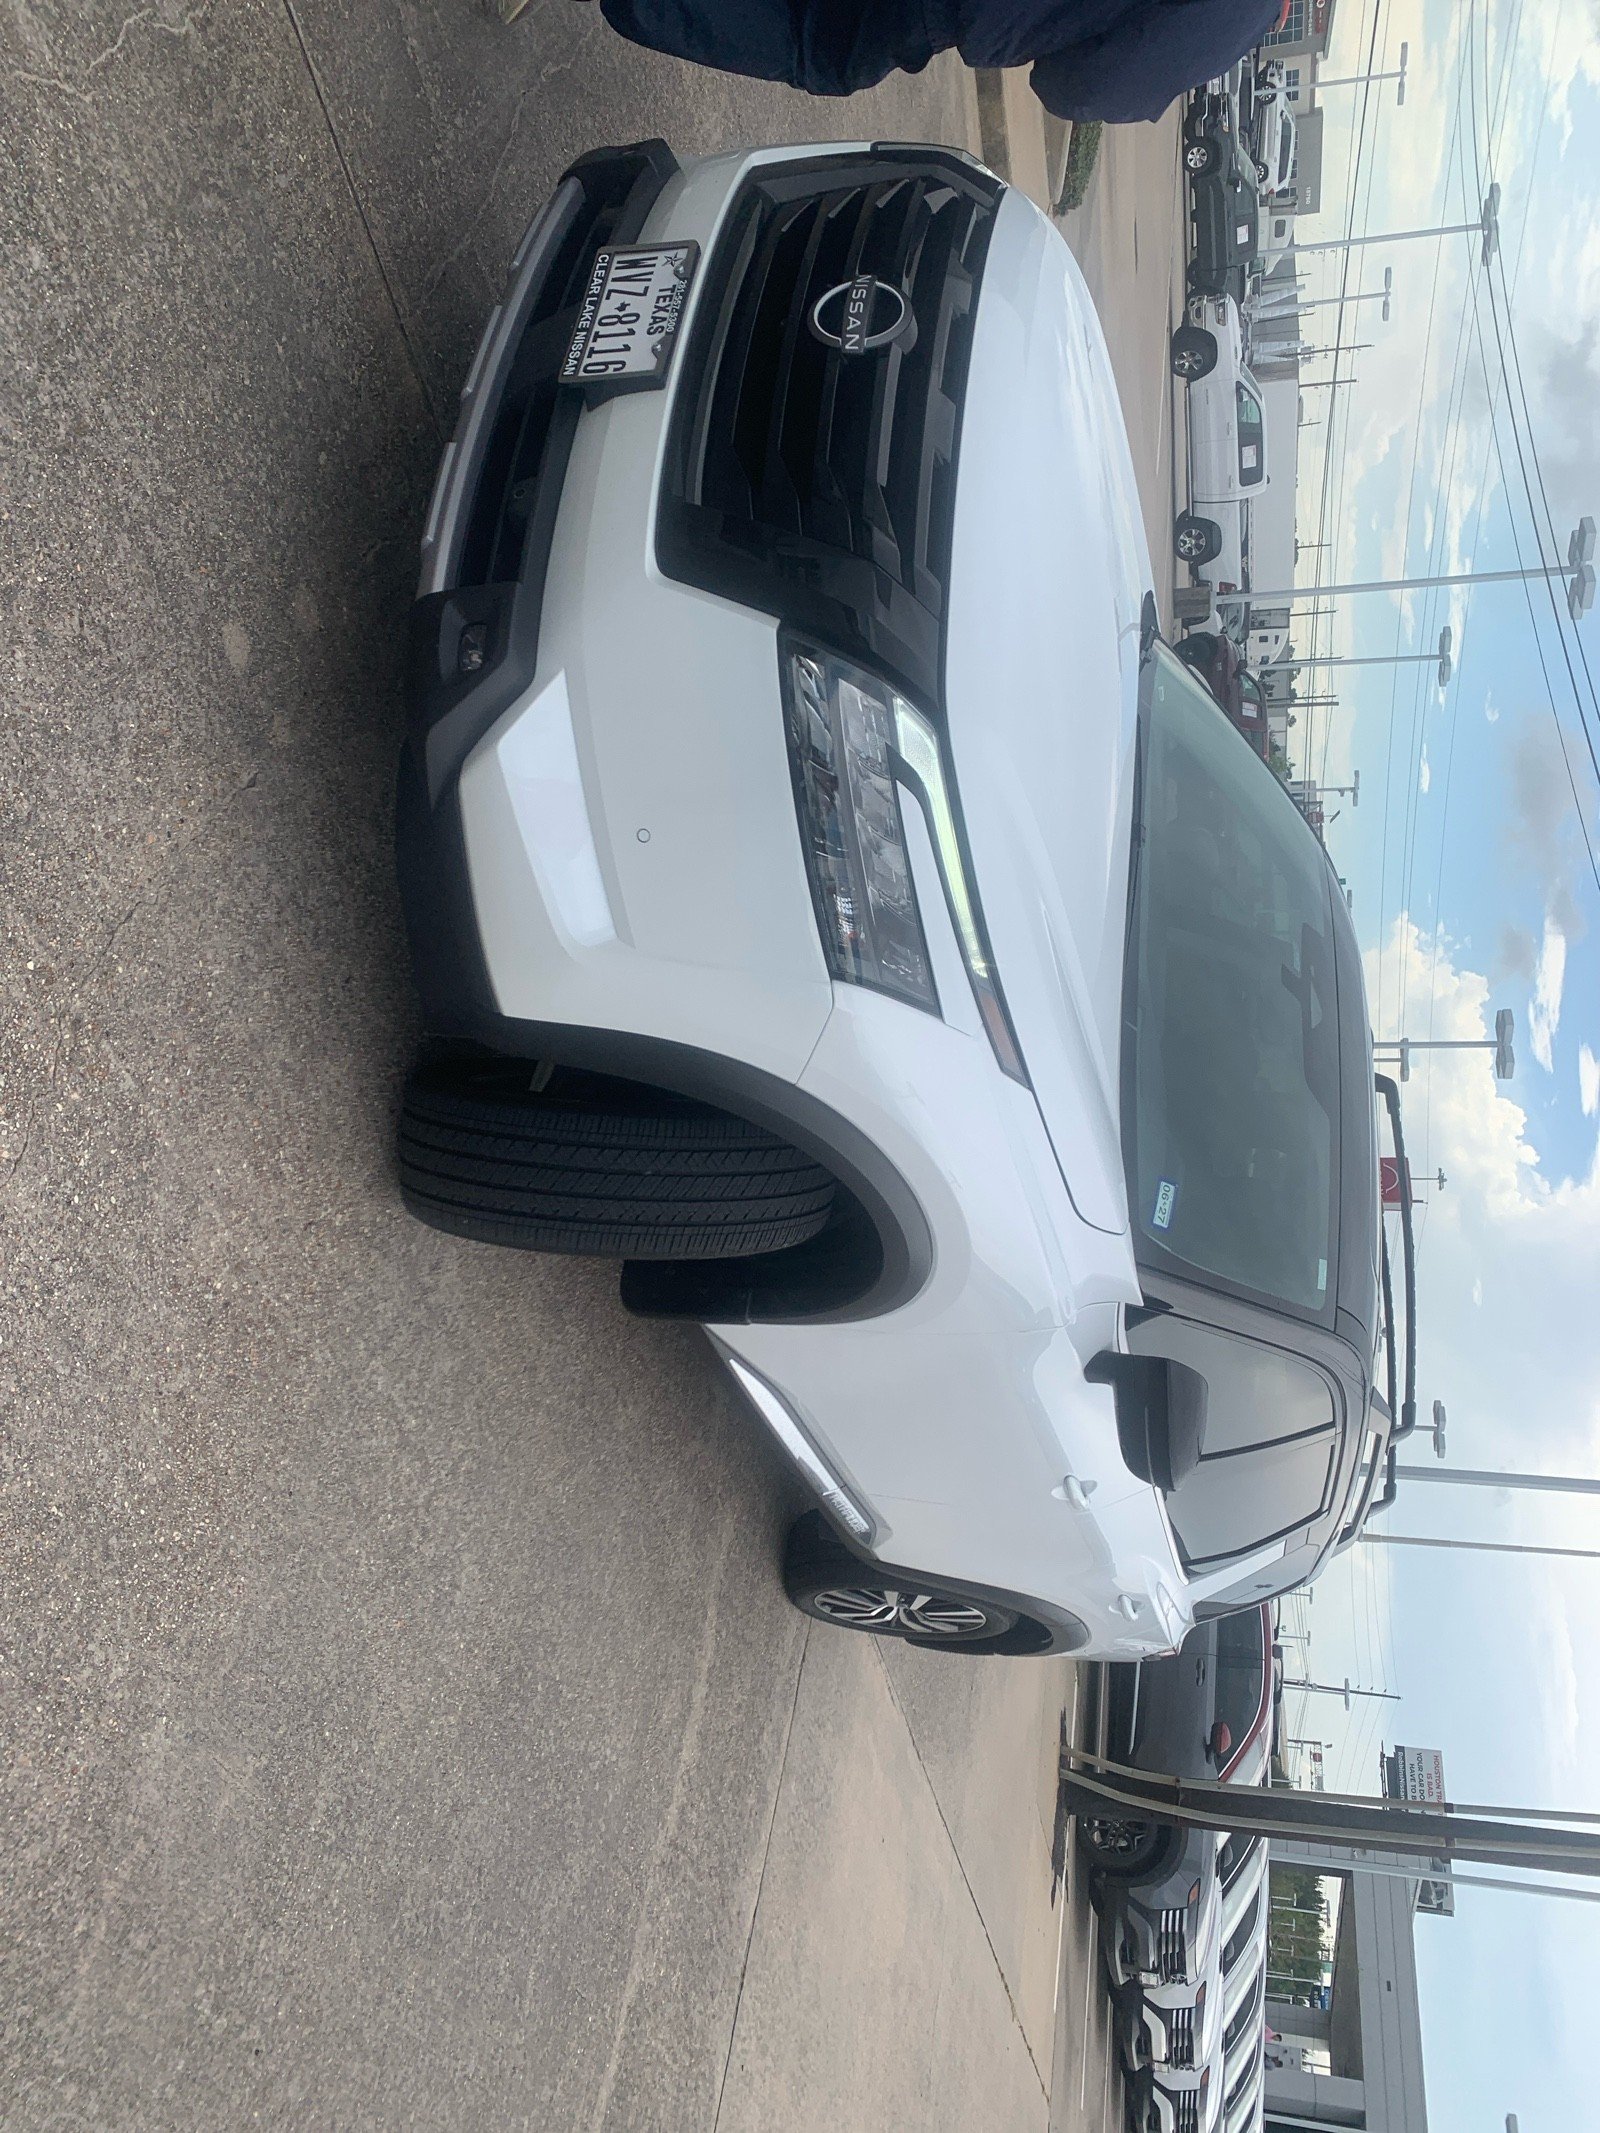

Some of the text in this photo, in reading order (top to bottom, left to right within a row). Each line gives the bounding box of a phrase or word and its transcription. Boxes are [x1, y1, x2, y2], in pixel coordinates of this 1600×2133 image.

[562, 254, 609, 376] CLEAR LAKE NISSAN
[646, 285, 676, 336] TEXAS
[844, 274, 872, 350] NISSAN
[1410, 1784, 1417, 1794] TO
[1433, 1755, 1442, 1790] HOUSTON
